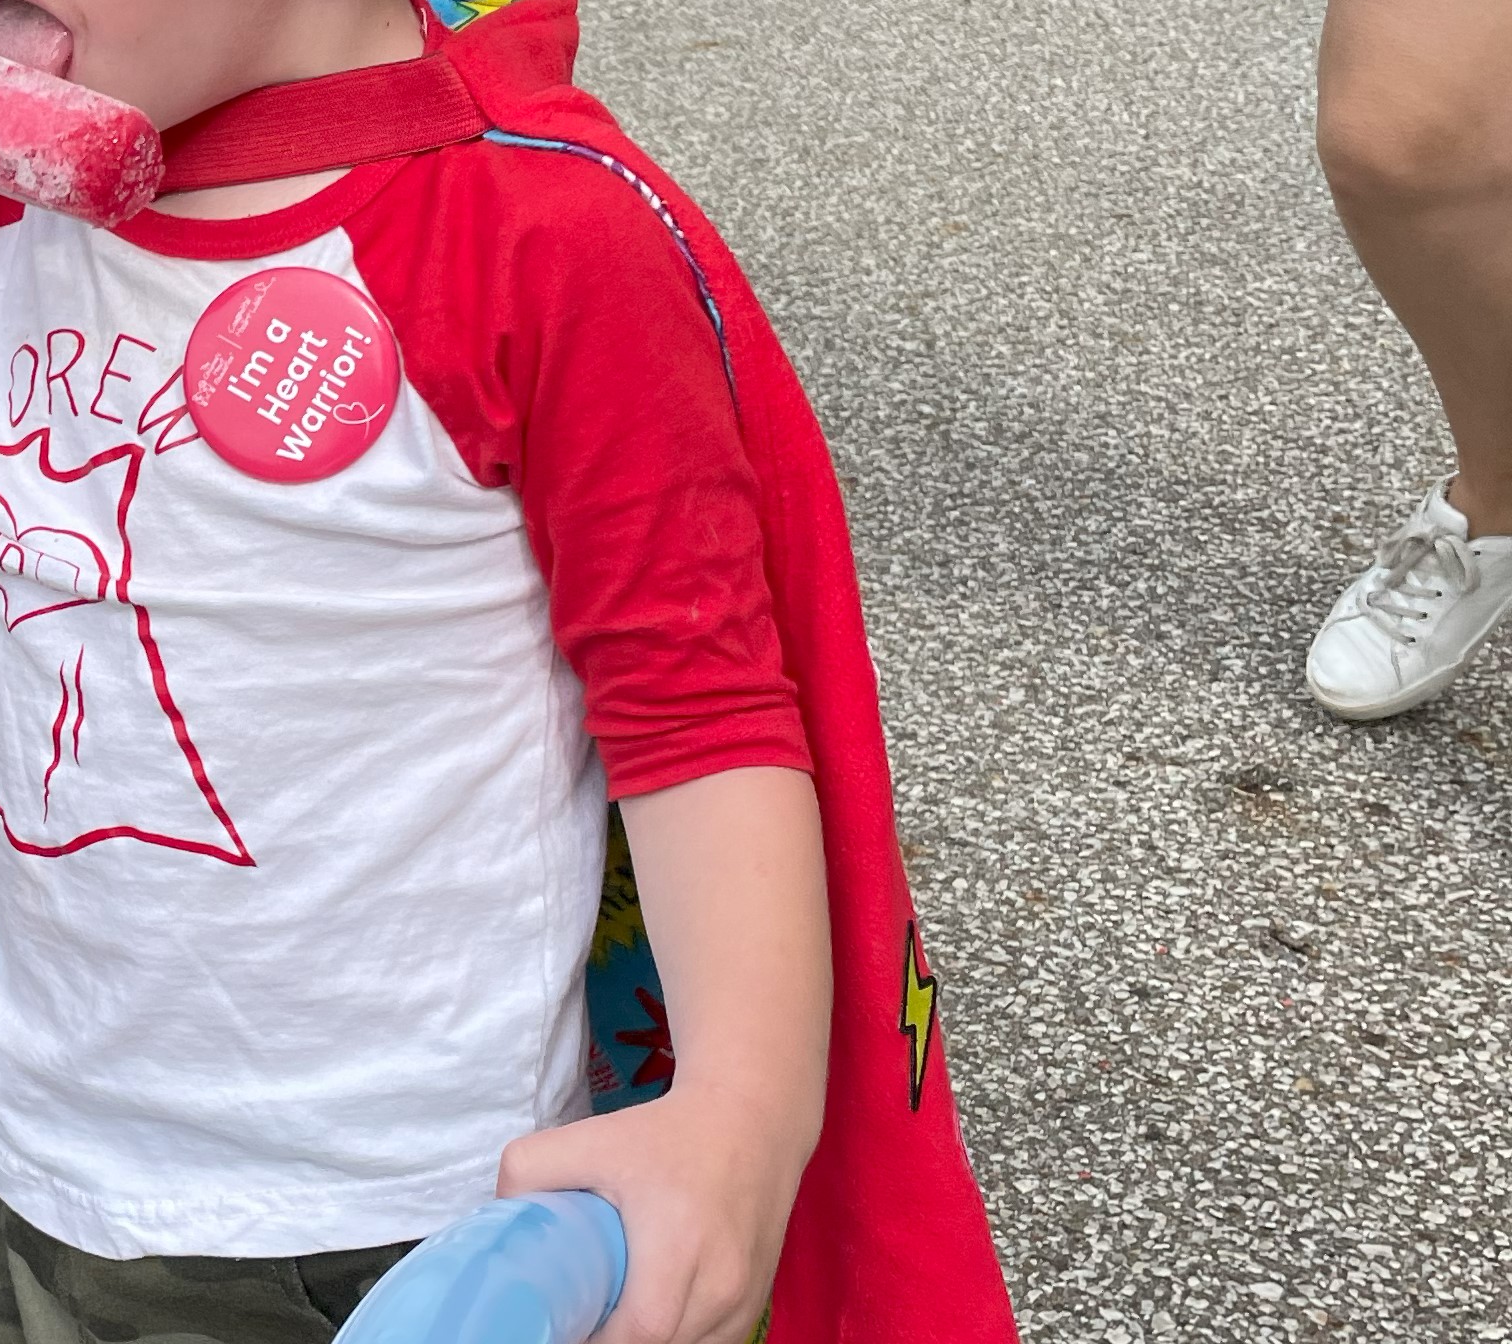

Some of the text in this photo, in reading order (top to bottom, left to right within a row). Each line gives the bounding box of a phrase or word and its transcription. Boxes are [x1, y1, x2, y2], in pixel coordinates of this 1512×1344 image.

[227, 349, 274, 402] I'm
[266, 318, 292, 345] a
[257, 330, 328, 425] Heart
[275, 326, 372, 462] Warrior!
